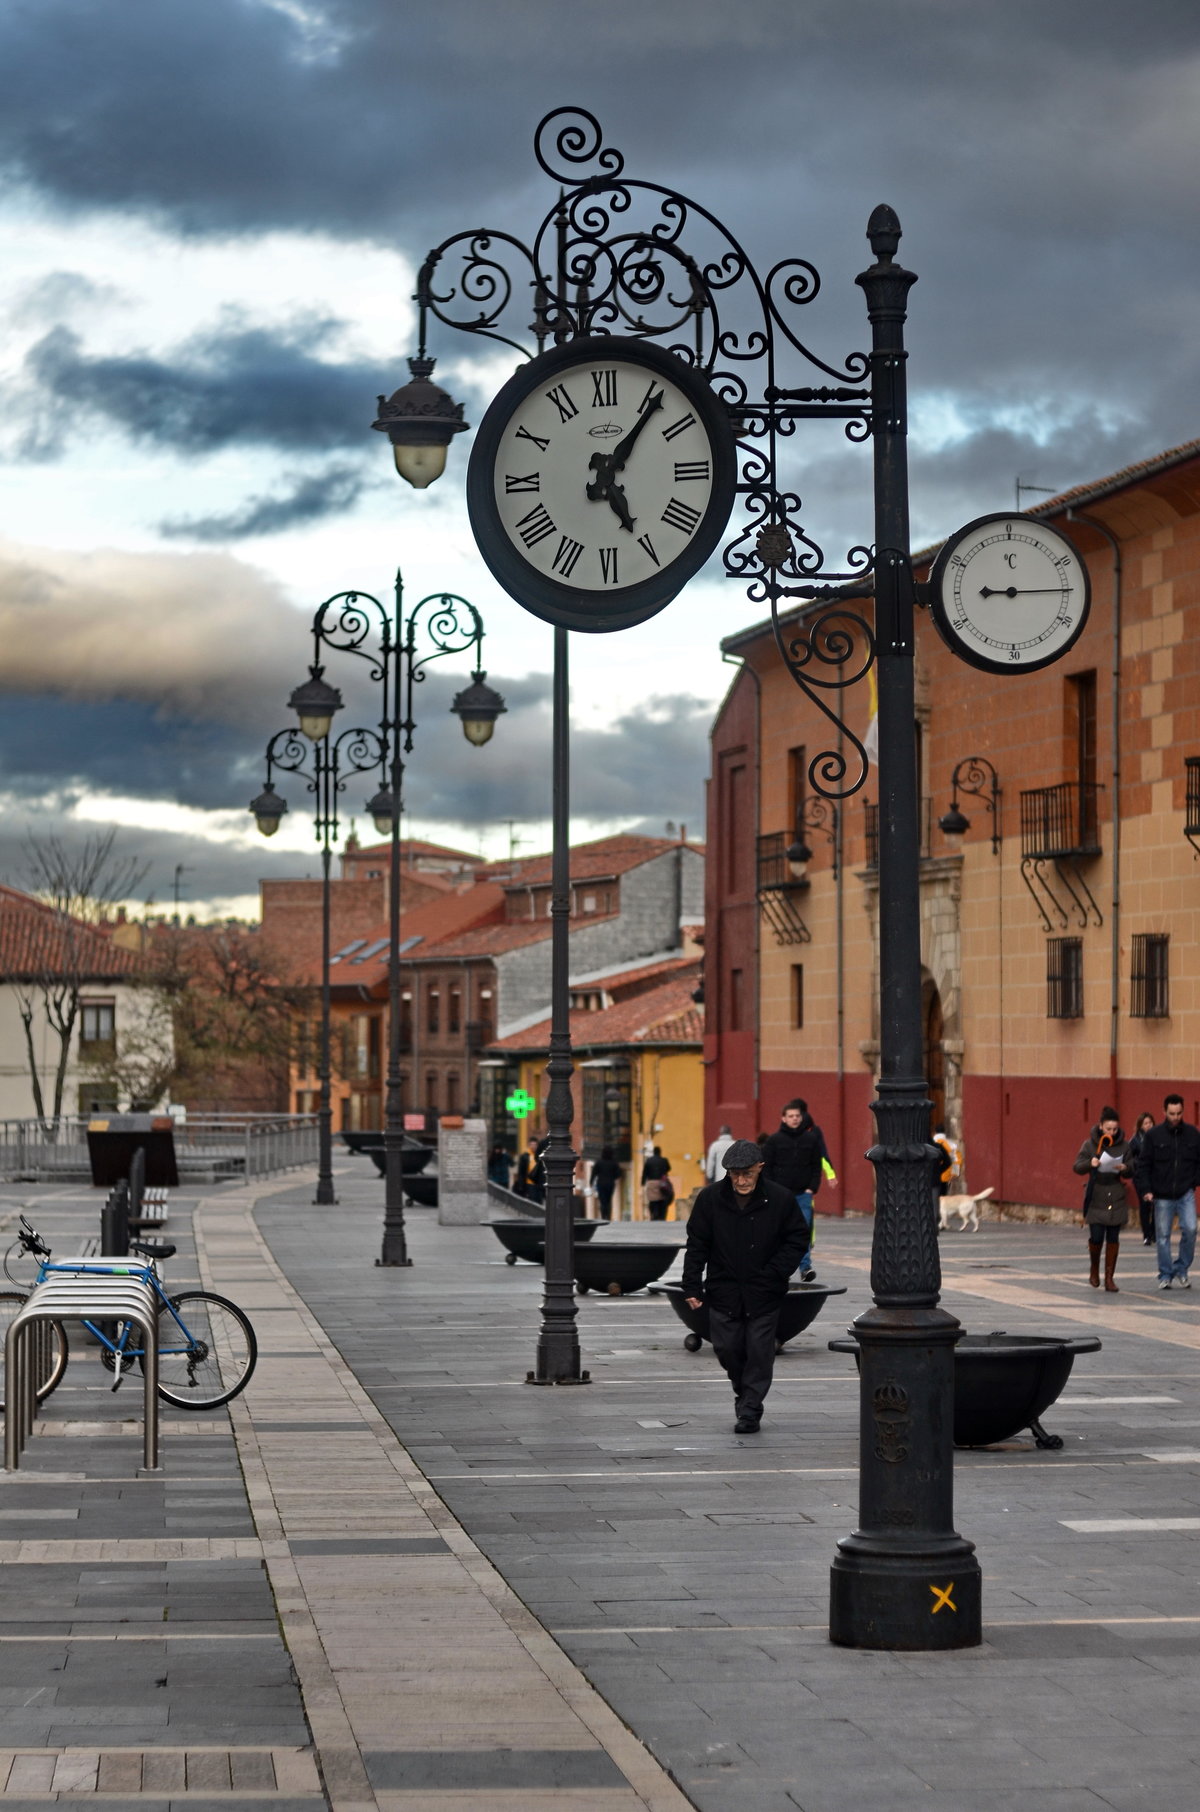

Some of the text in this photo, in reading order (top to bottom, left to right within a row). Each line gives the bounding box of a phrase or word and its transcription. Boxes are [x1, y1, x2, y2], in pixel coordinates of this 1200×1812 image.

[591, 370, 618, 408] XII
[546, 383, 580, 424] XI
[515, 425, 551, 452] X
[662, 412, 697, 442] II
[505, 471, 540, 494] IX
[674, 460, 709, 482] III
[515, 503, 557, 549] VIII
[661, 497, 702, 536] IIII
[1006, 523, 1012, 534] 0
[551, 535, 585, 578] VII
[637, 533, 661, 568] V
[1060, 554, 1071, 566] 10
[599, 547, 619, 585] VI
[952, 619, 964, 631] 40
[1061, 615, 1073, 629] 20
[1008, 651, 1020, 661] 30
